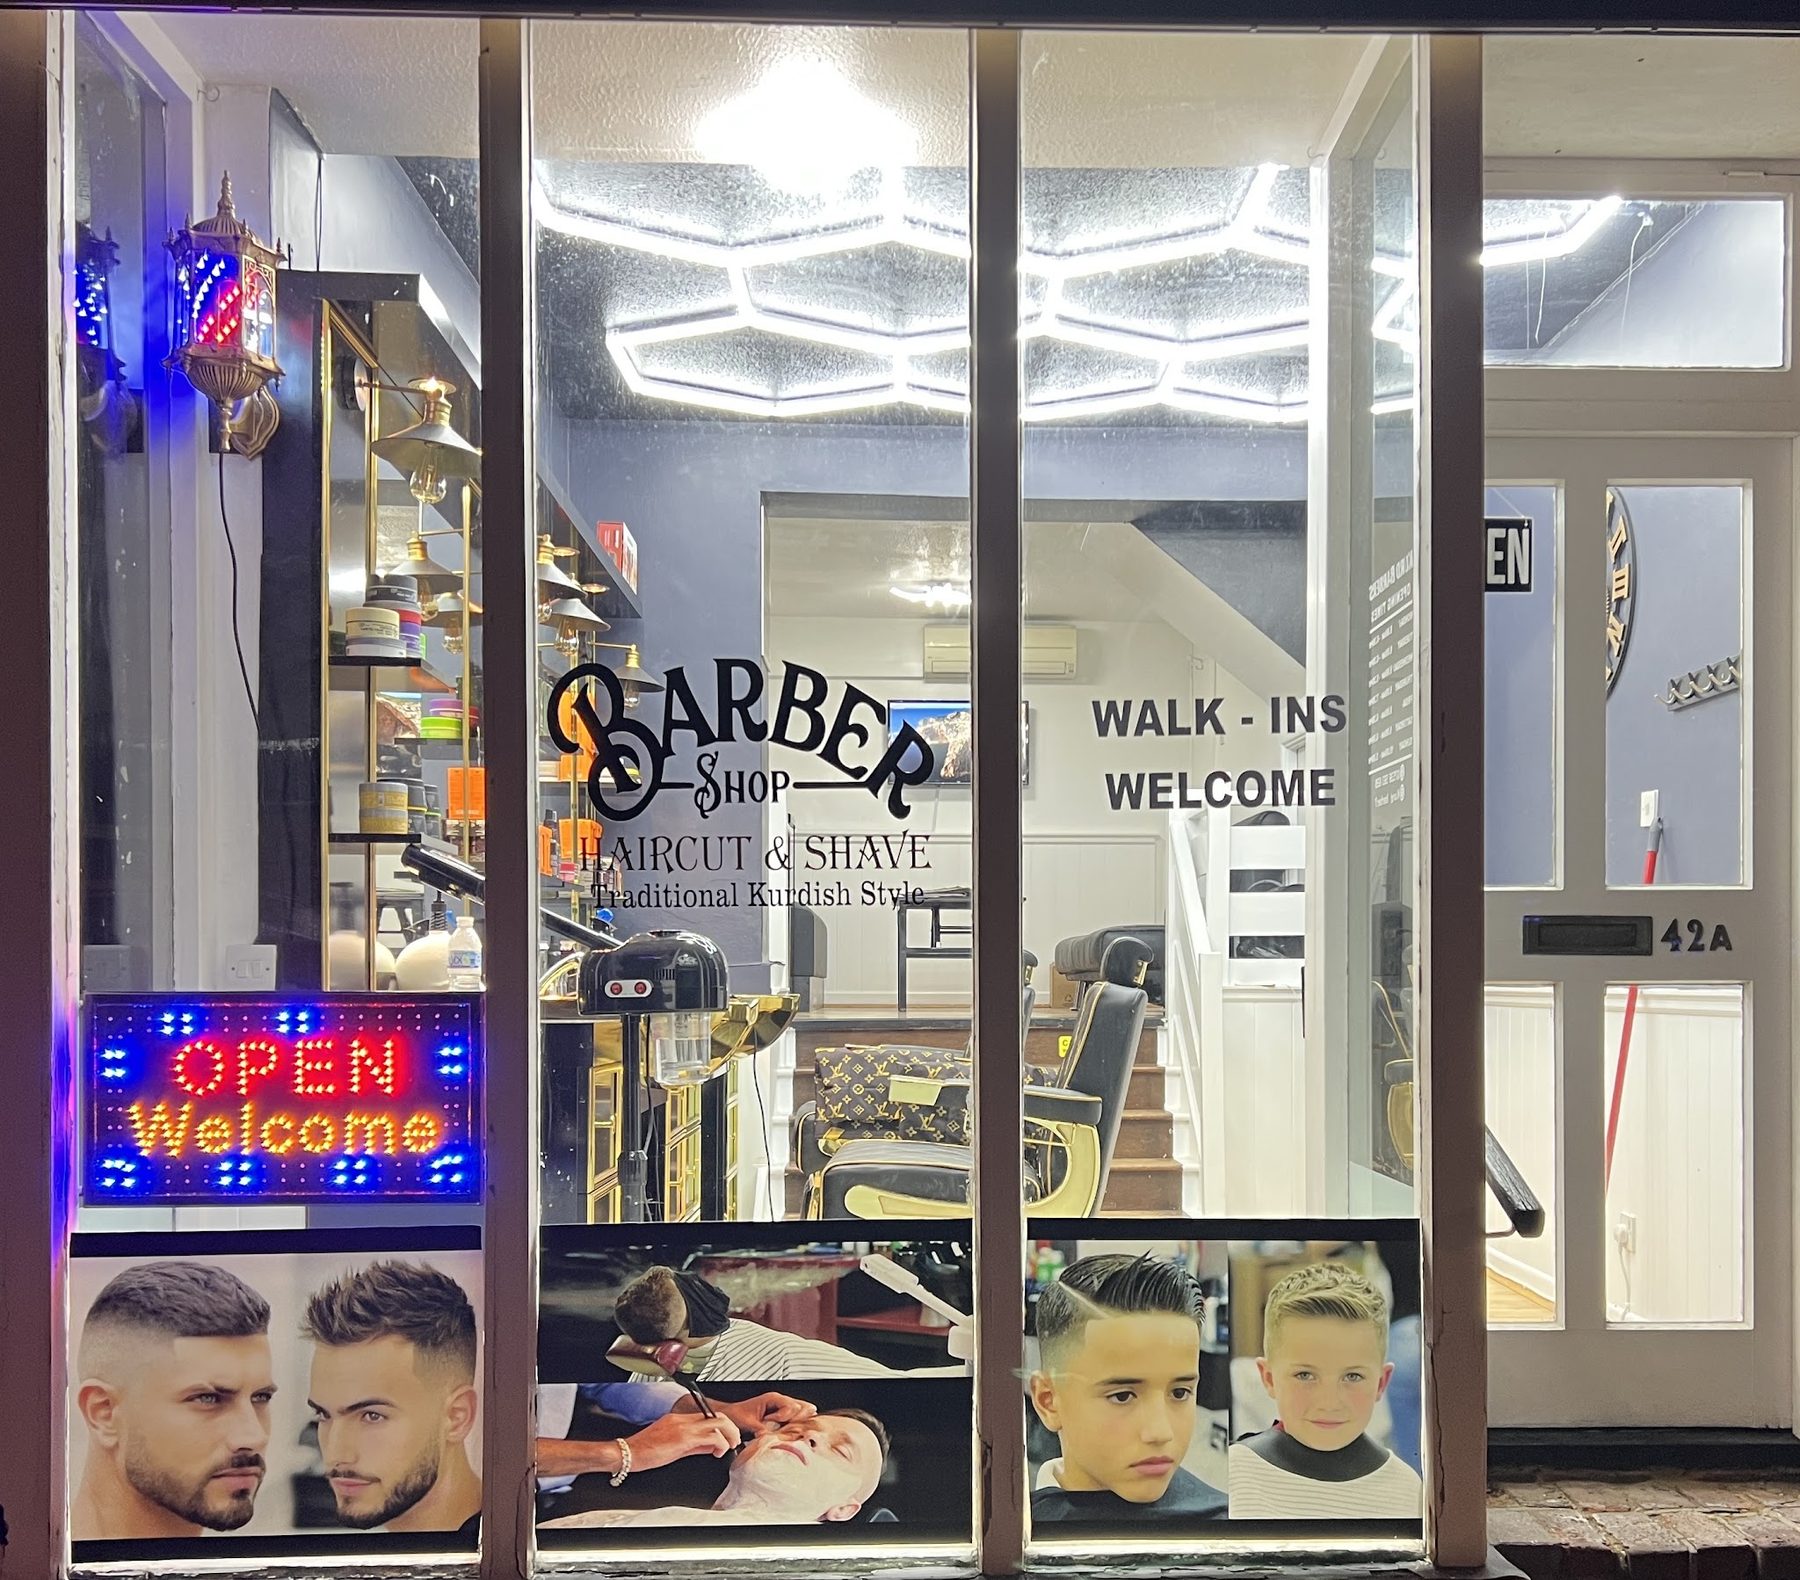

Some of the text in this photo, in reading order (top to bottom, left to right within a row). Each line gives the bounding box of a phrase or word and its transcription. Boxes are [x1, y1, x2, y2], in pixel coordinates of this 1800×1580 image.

[1092, 697, 1226, 738] WALK
[1270, 694, 1347, 734] INS
[547, 658, 934, 821] BARBER
[694, 751, 790, 819] SHOP
[1105, 768, 1336, 810] WELCOME
[579, 829, 932, 874] HAIRCUT & SHAVE
[591, 879, 925, 910] Traditional Kurdish Style
[1661, 918, 1733, 952] 42A
[172, 1039, 396, 1097] OPEN
[125, 1100, 442, 1158] Welcome
